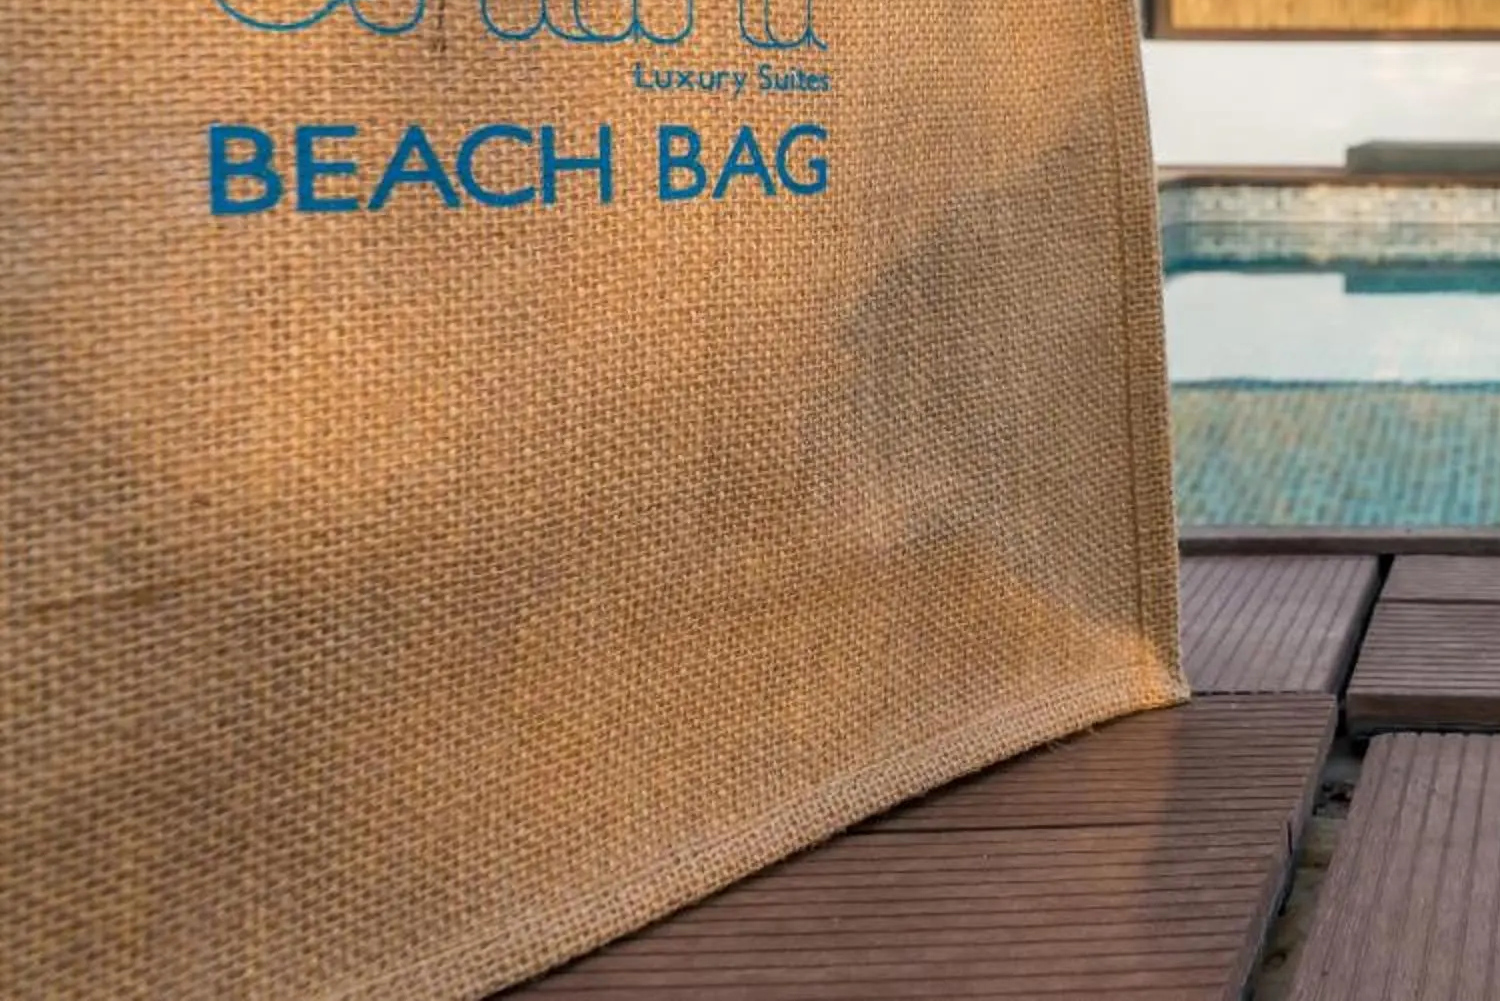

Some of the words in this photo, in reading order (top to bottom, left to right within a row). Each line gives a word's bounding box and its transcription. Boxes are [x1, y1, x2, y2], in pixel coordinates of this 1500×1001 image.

[632, 63, 748, 95] Luxury
[757, 63, 831, 92] Suites
[206, 122, 614, 216] BEACH
[656, 124, 829, 201] BAG
